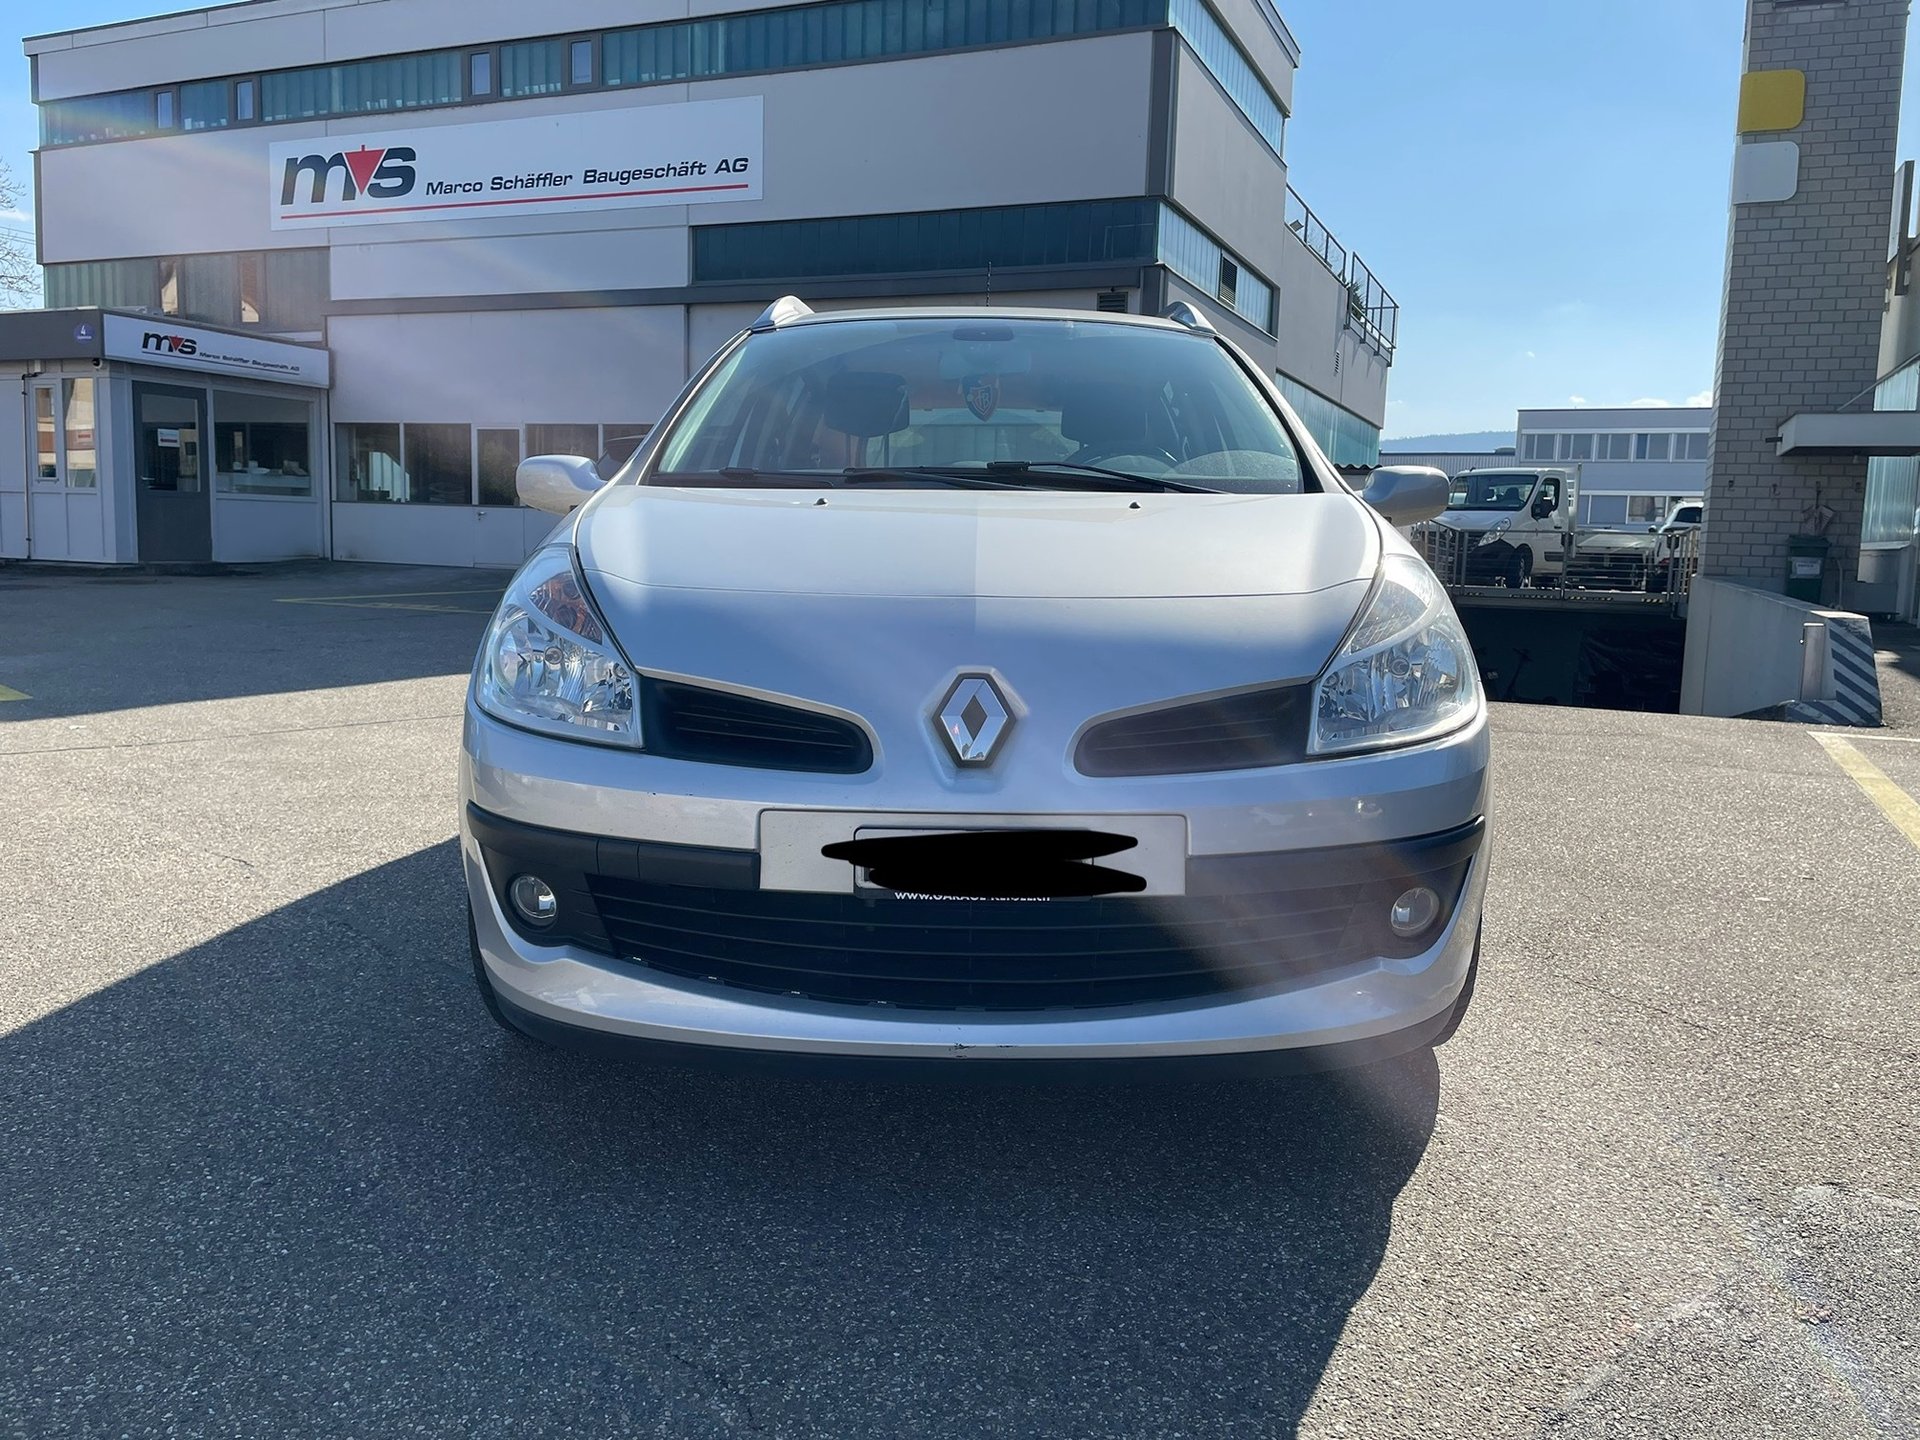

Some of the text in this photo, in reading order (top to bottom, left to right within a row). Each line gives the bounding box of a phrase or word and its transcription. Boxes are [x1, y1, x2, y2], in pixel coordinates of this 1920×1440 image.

[425, 181, 483, 196] Marco
[490, 172, 573, 191] Schäffler
[582, 161, 707, 186] Baugeschäft
[713, 157, 749, 174] AG
